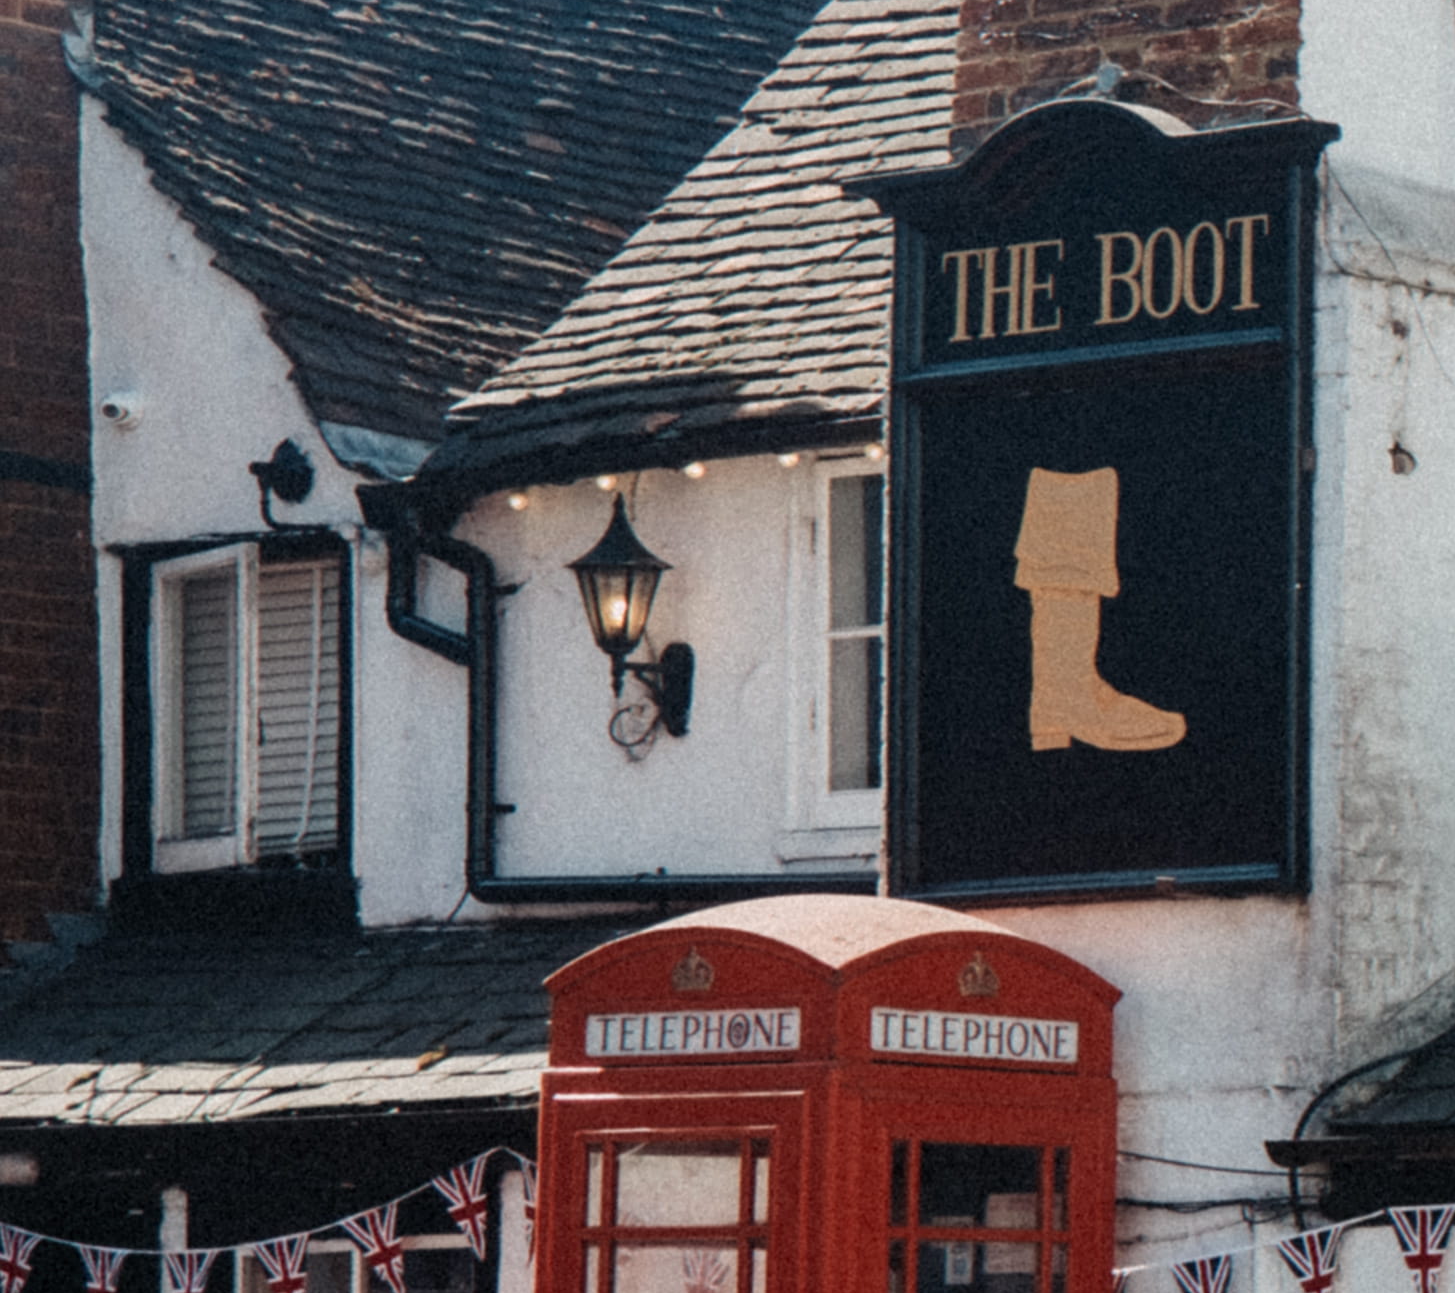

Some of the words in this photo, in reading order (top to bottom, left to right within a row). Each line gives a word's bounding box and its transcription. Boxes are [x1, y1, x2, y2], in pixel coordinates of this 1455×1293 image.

[942, 239, 1064, 343] THE
[1094, 214, 1270, 326] BOOT
[596, 1012, 794, 1053] TELEPHONE
[878, 1012, 1071, 1059] TELEPHONE
